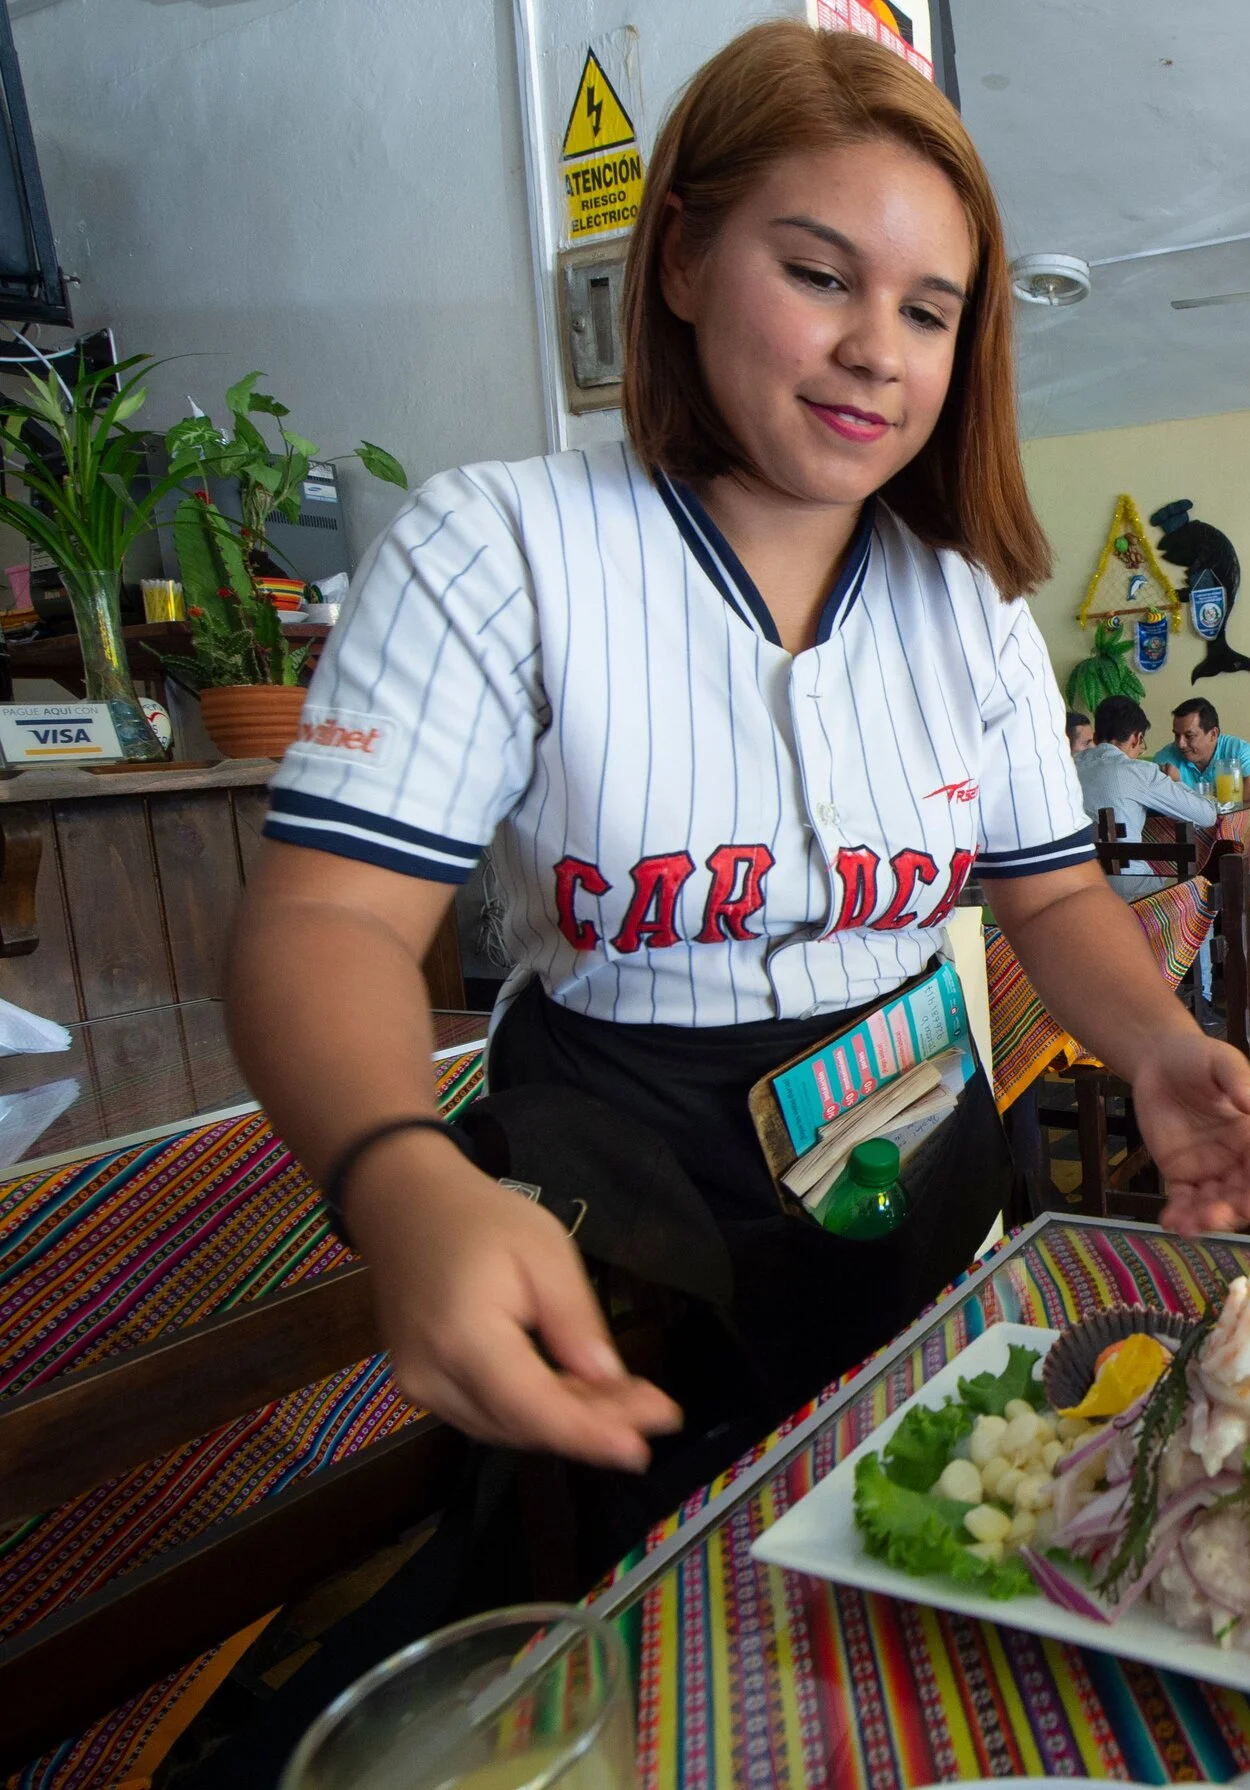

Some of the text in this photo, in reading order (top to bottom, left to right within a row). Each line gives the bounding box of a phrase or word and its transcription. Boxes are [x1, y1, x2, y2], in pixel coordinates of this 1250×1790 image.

[565, 154, 641, 196] ATENCIÓN
[581, 191, 626, 211] RIESGO
[2, 708, 40, 717] PAGUE
[75, 706, 98, 715] CON
[26, 729, 92, 744] VISA
